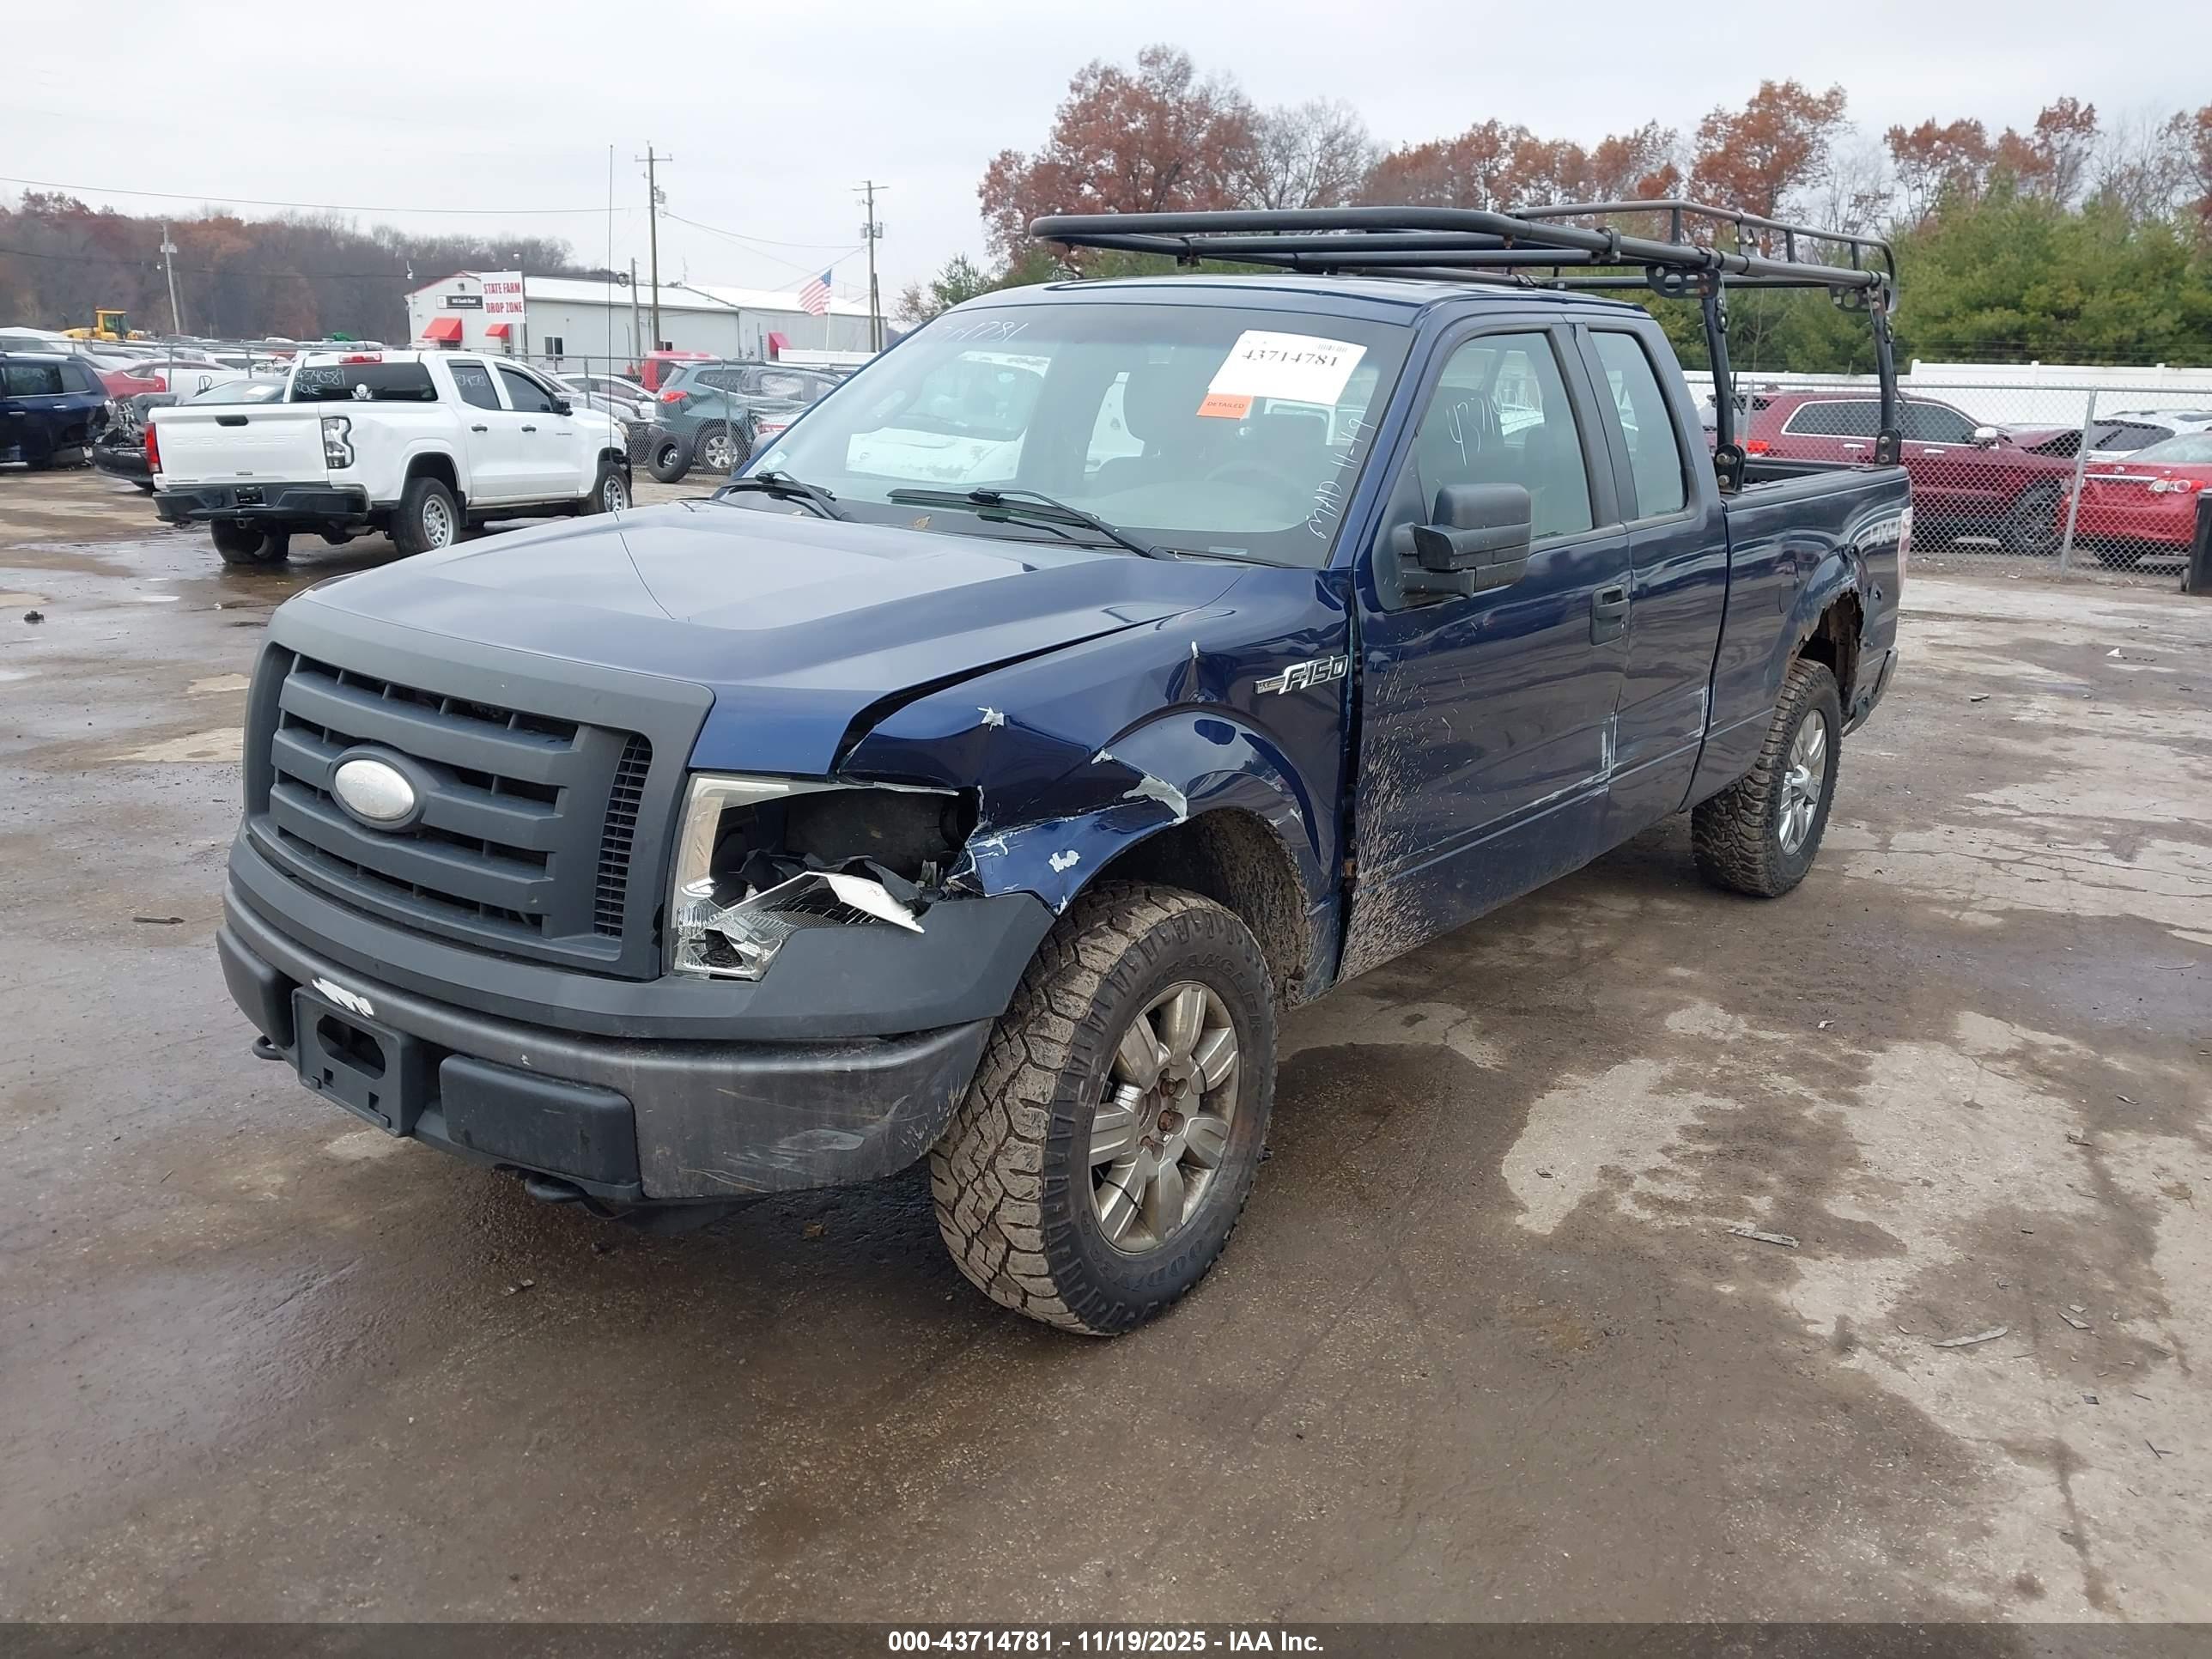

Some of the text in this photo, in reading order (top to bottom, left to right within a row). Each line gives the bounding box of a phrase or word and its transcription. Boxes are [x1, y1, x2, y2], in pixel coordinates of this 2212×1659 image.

[483, 282, 521, 295] STATE FARM
[485, 301, 523, 313] DROP ZONE
[1242, 349, 1338, 367] 43714781
